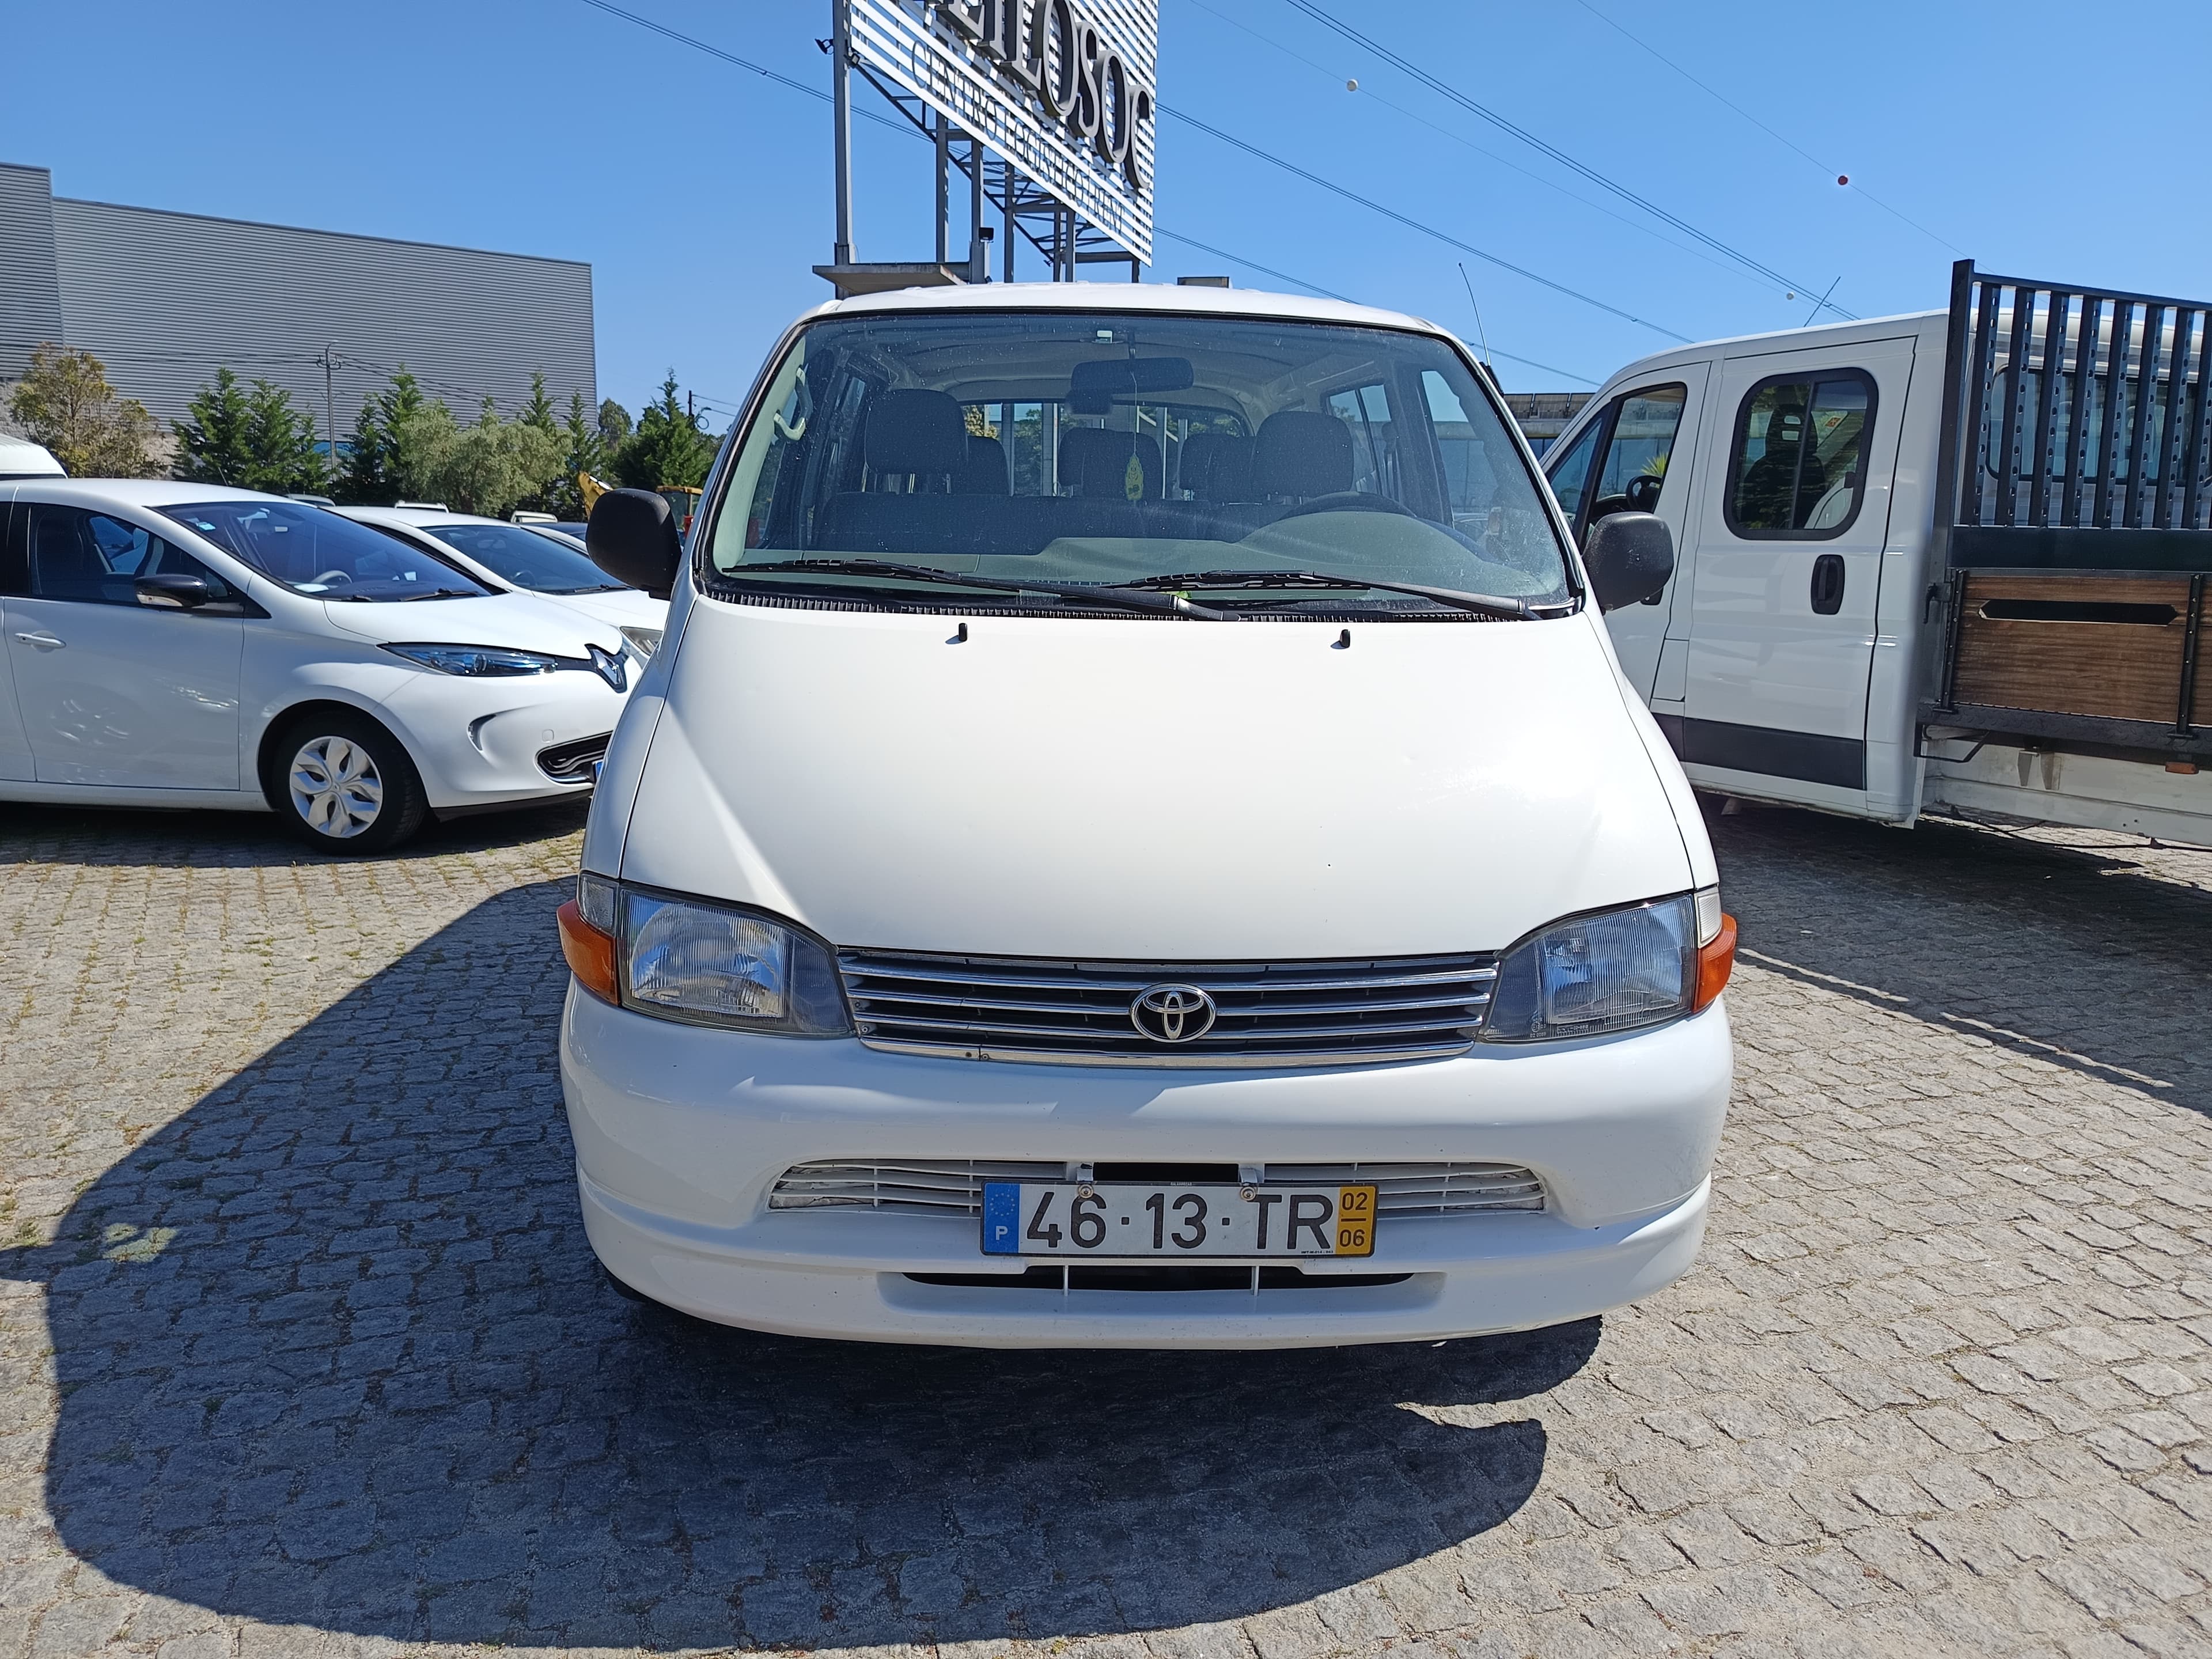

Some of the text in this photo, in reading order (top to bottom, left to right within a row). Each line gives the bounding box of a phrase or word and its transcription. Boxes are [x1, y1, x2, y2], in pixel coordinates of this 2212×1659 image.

[912, 40, 997, 141] CENTRO
[1342, 1192, 1368, 1211] 02
[995, 1225, 1008, 1240] P
[1339, 1229, 1365, 1247] 06
